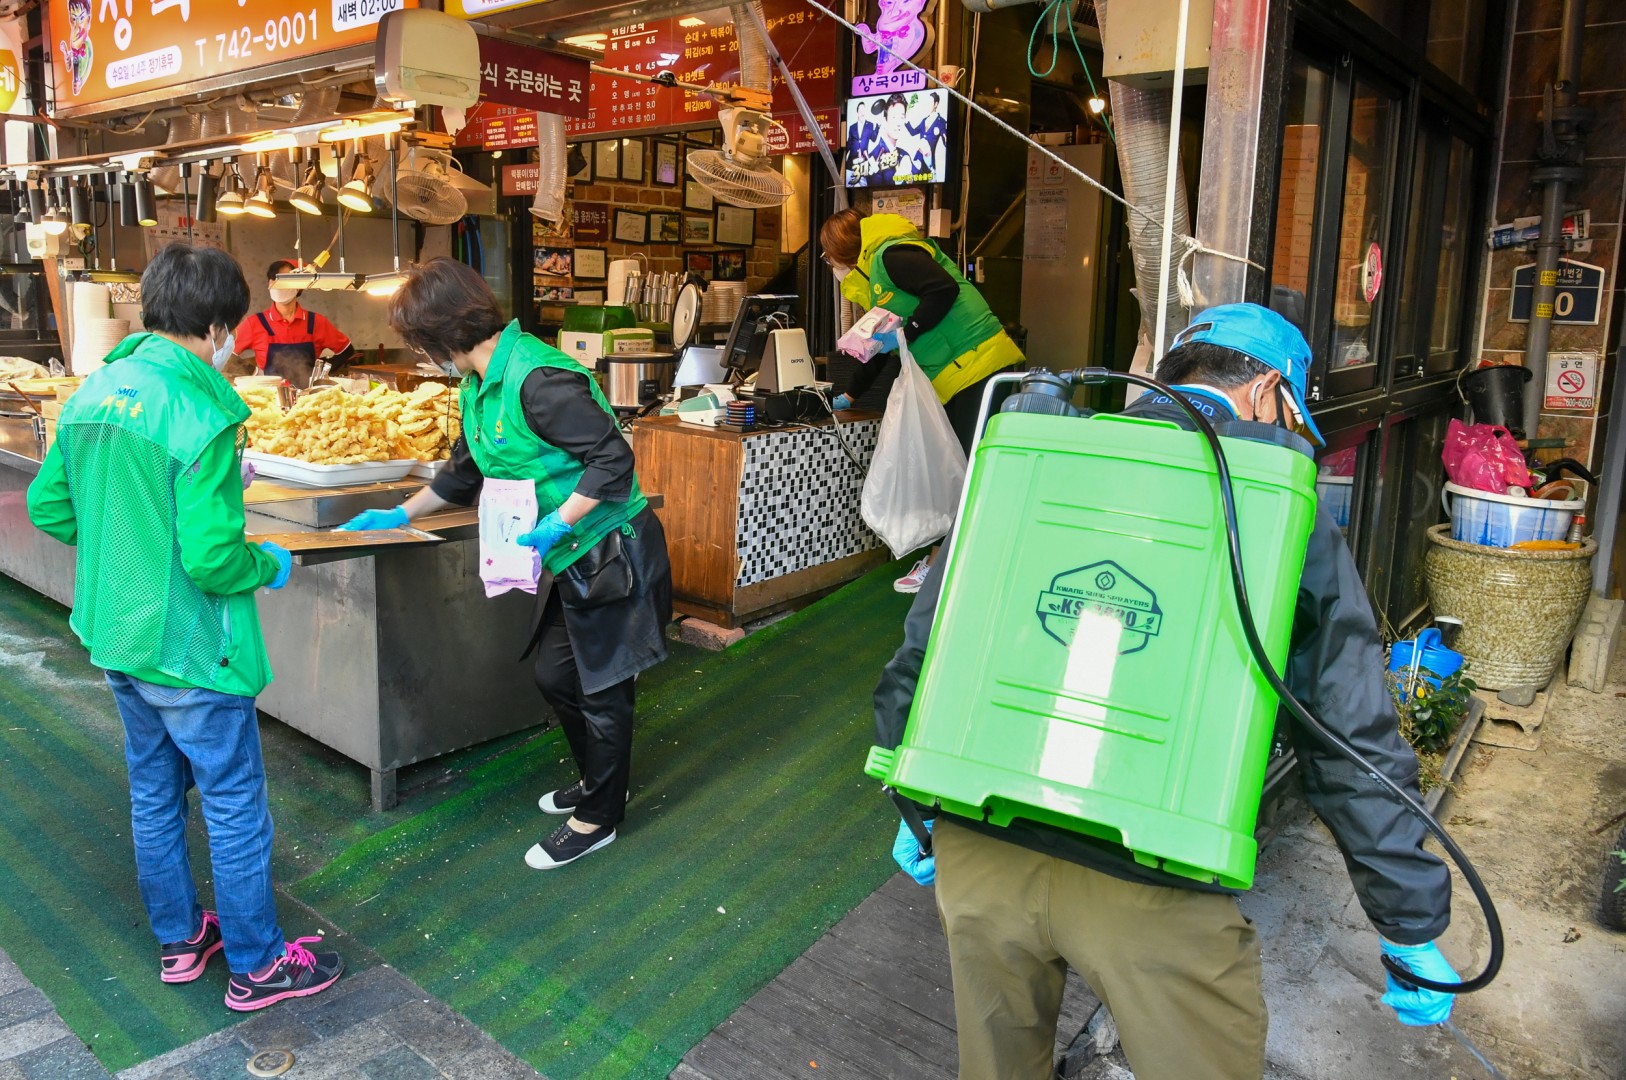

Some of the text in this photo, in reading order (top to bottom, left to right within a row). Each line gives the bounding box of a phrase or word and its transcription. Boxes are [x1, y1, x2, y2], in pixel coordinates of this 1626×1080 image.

[337, 1, 357, 22] 새벽
[684, 31, 699, 43] 순대
[710, 25, 733, 38] 떡볶이
[787, 12, 804, 24] 오뎅
[195, 38, 207, 67] T
[215, 8, 318, 62] 742-9001
[646, 36, 656, 45] 4.5
[112, 66, 129, 82] 수요일
[148, 53, 174, 74] 정기휴무
[646, 61, 656, 70] 4.5
[480, 62, 582, 103] 식 주문하는 곳
[858, 72, 920, 93] 상국이네
[646, 87, 656, 96] 3.5
[646, 100, 656, 109] 9.0
[587, 121, 596, 129] 2.0
[644, 113, 656, 122] 10.0
[601, 211, 607, 224] 곳
[1056, 585, 1084, 595] KWANG
[1107, 594, 1150, 608] SPRAYERS
